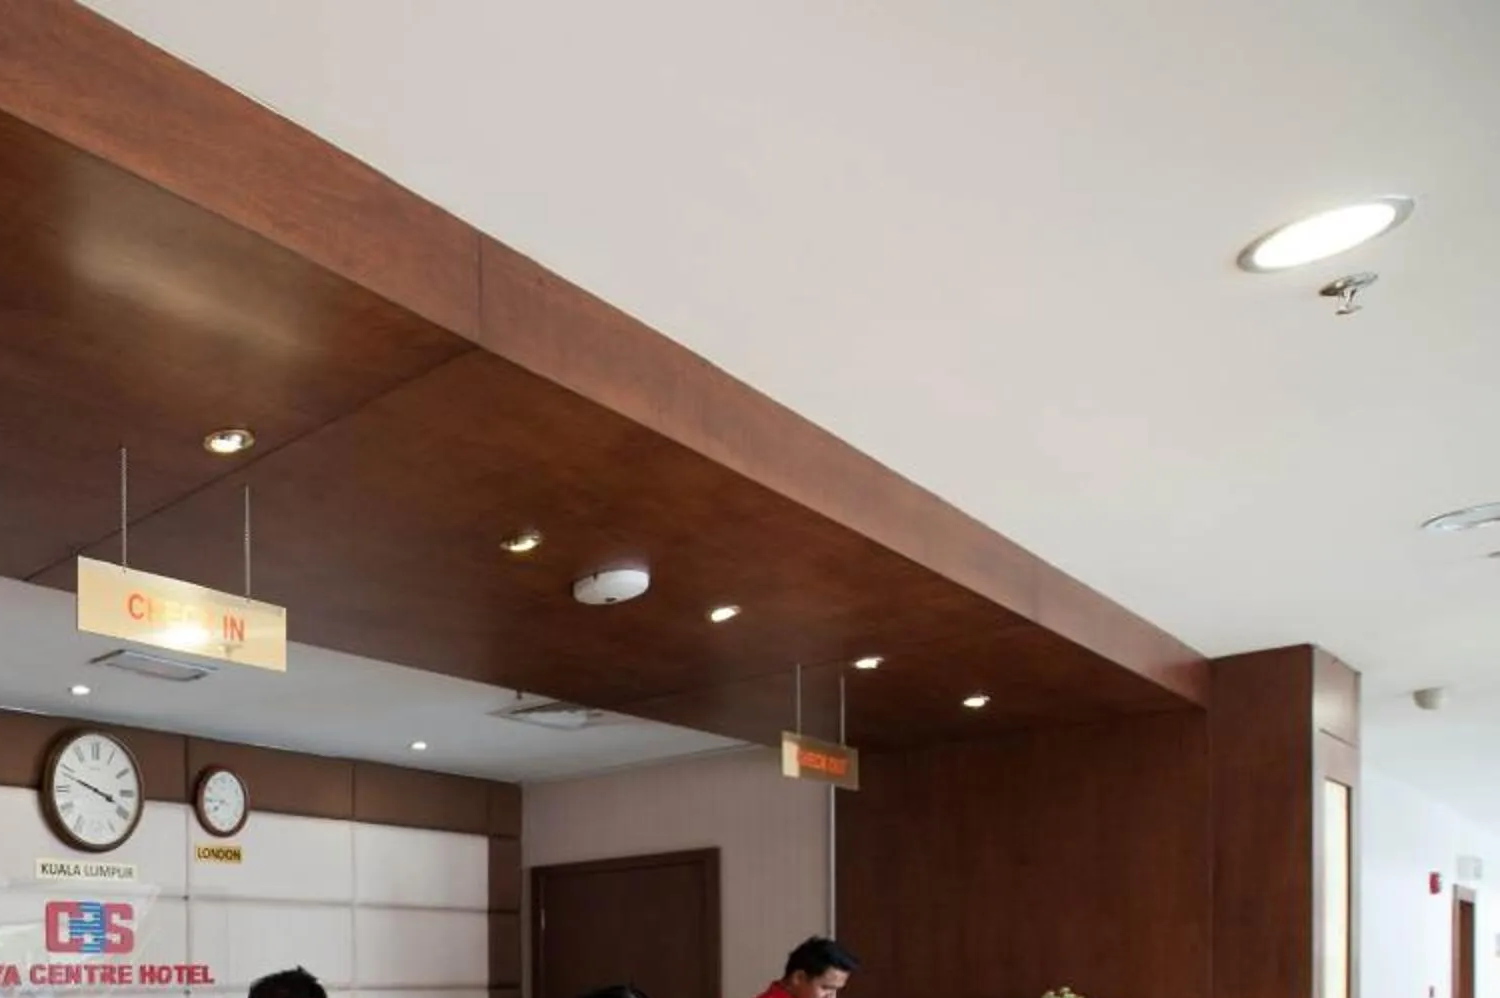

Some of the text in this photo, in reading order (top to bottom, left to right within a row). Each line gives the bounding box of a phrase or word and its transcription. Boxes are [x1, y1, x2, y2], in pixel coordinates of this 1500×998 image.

[223, 615, 245, 642] IN
[197, 847, 242, 861] LONDON
[41, 863, 134, 879] KUALA LUMPUR
[29, 964, 133, 986] CENTRE
[139, 965, 215, 985] HOTEL
